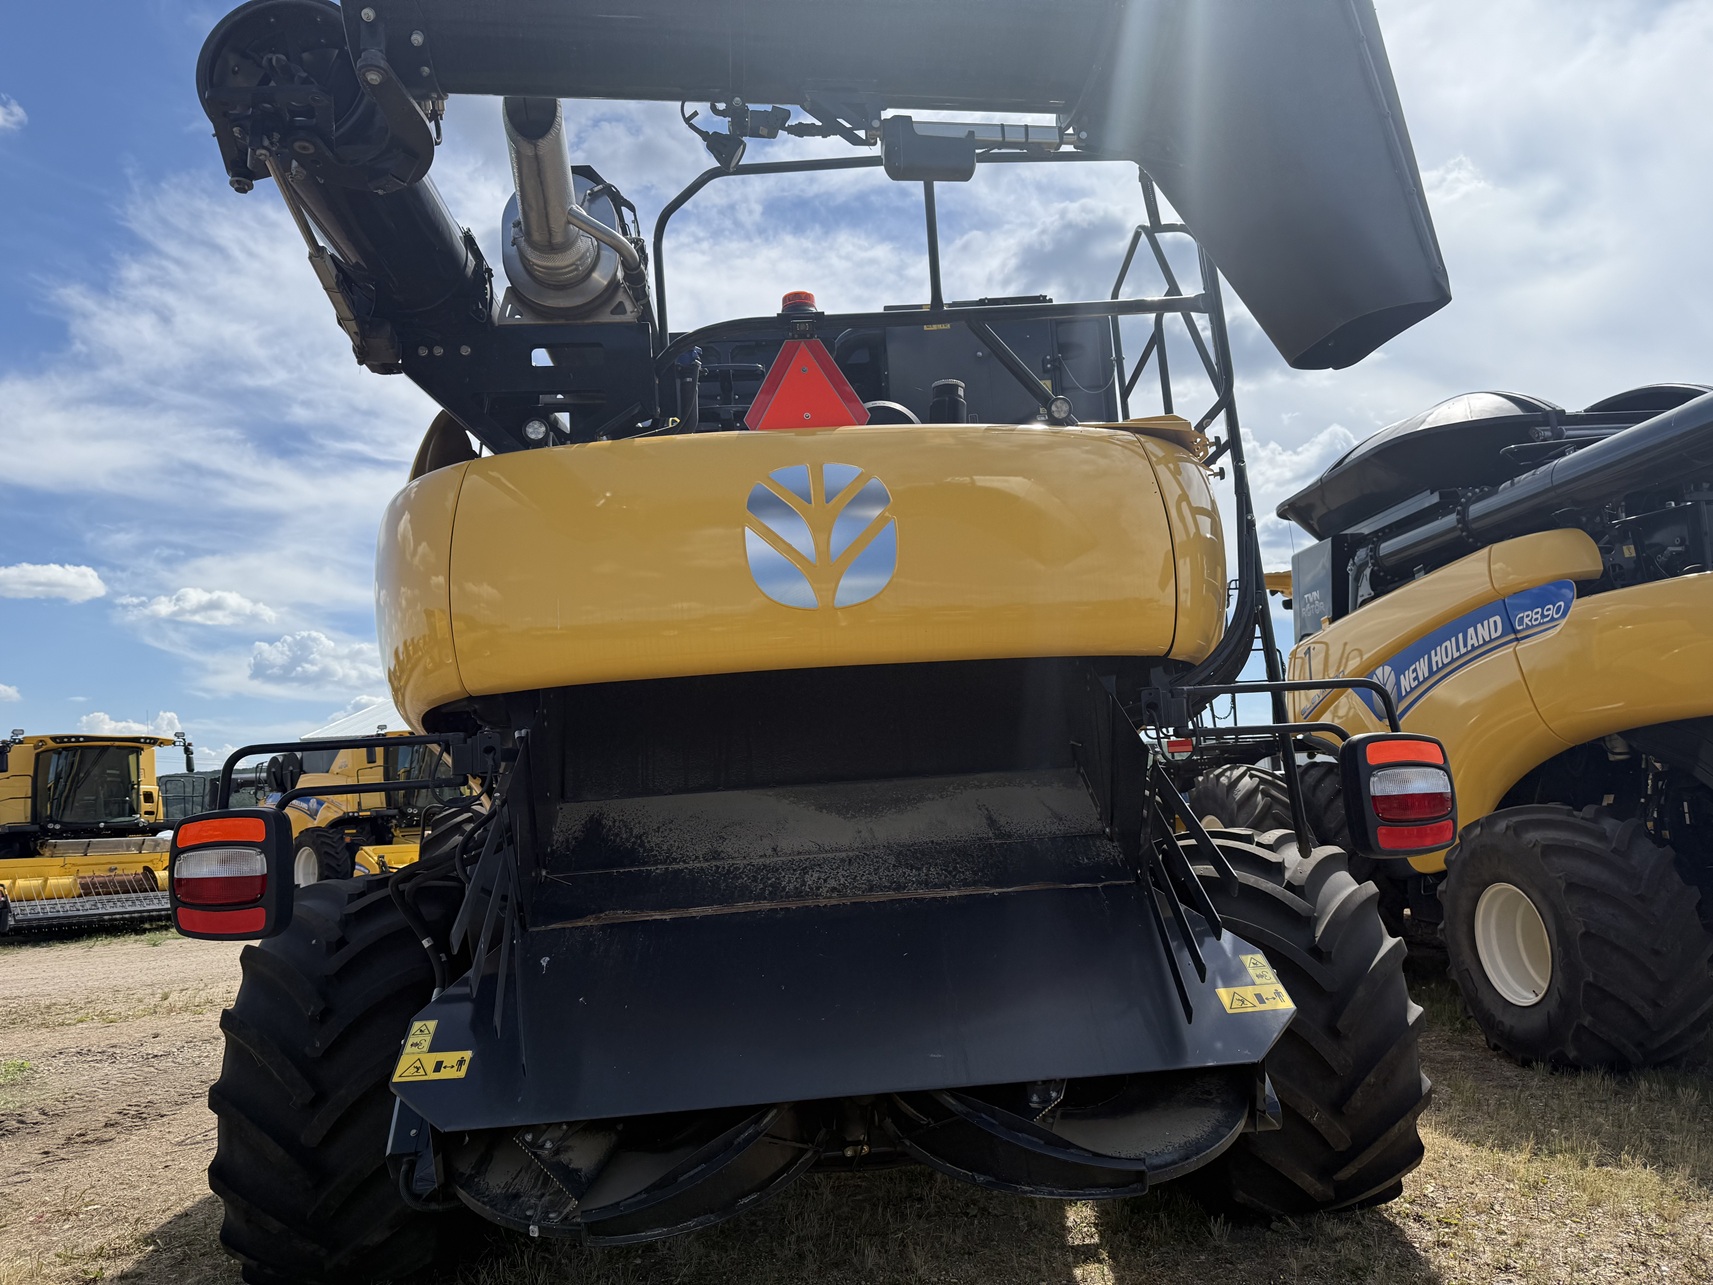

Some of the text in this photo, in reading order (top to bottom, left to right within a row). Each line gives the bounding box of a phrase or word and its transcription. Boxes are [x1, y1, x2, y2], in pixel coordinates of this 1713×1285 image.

[1302, 601, 1326, 616] ROTOR
[1515, 601, 1565, 630] CR8.90
[1400, 615, 1502, 696] NEW HOLLAND
